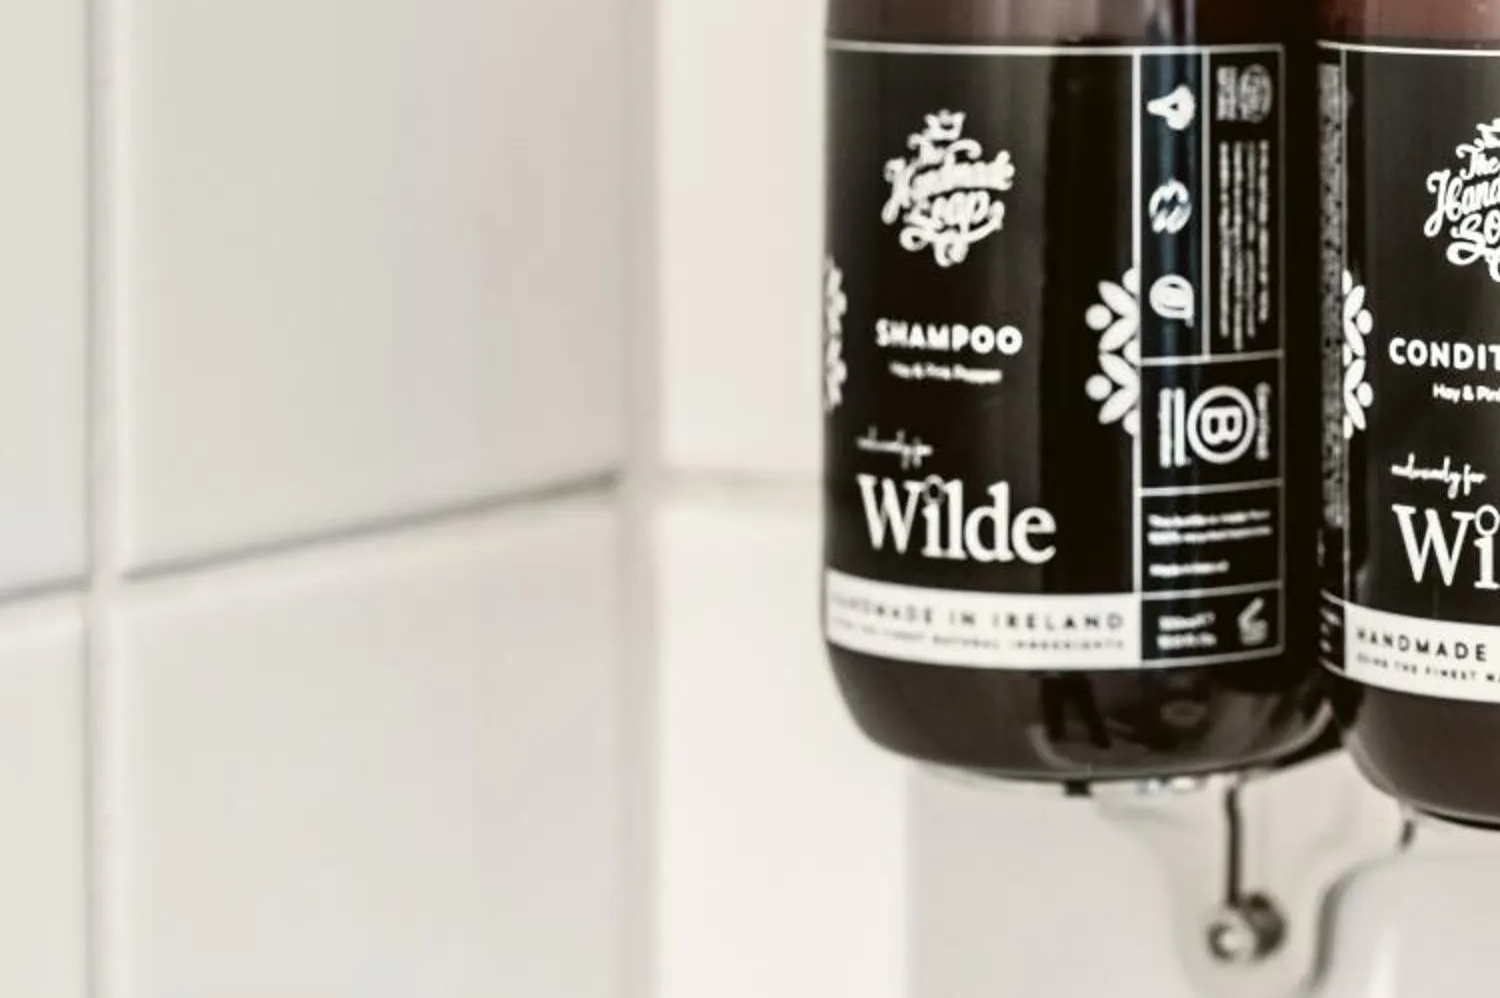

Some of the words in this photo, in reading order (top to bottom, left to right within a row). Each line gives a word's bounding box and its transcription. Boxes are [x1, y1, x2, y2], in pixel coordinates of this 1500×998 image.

[875, 317, 1023, 355] SHAMPOO
[856, 473, 1056, 564] Wilde
[1357, 628, 1487, 662] HANDMADE
